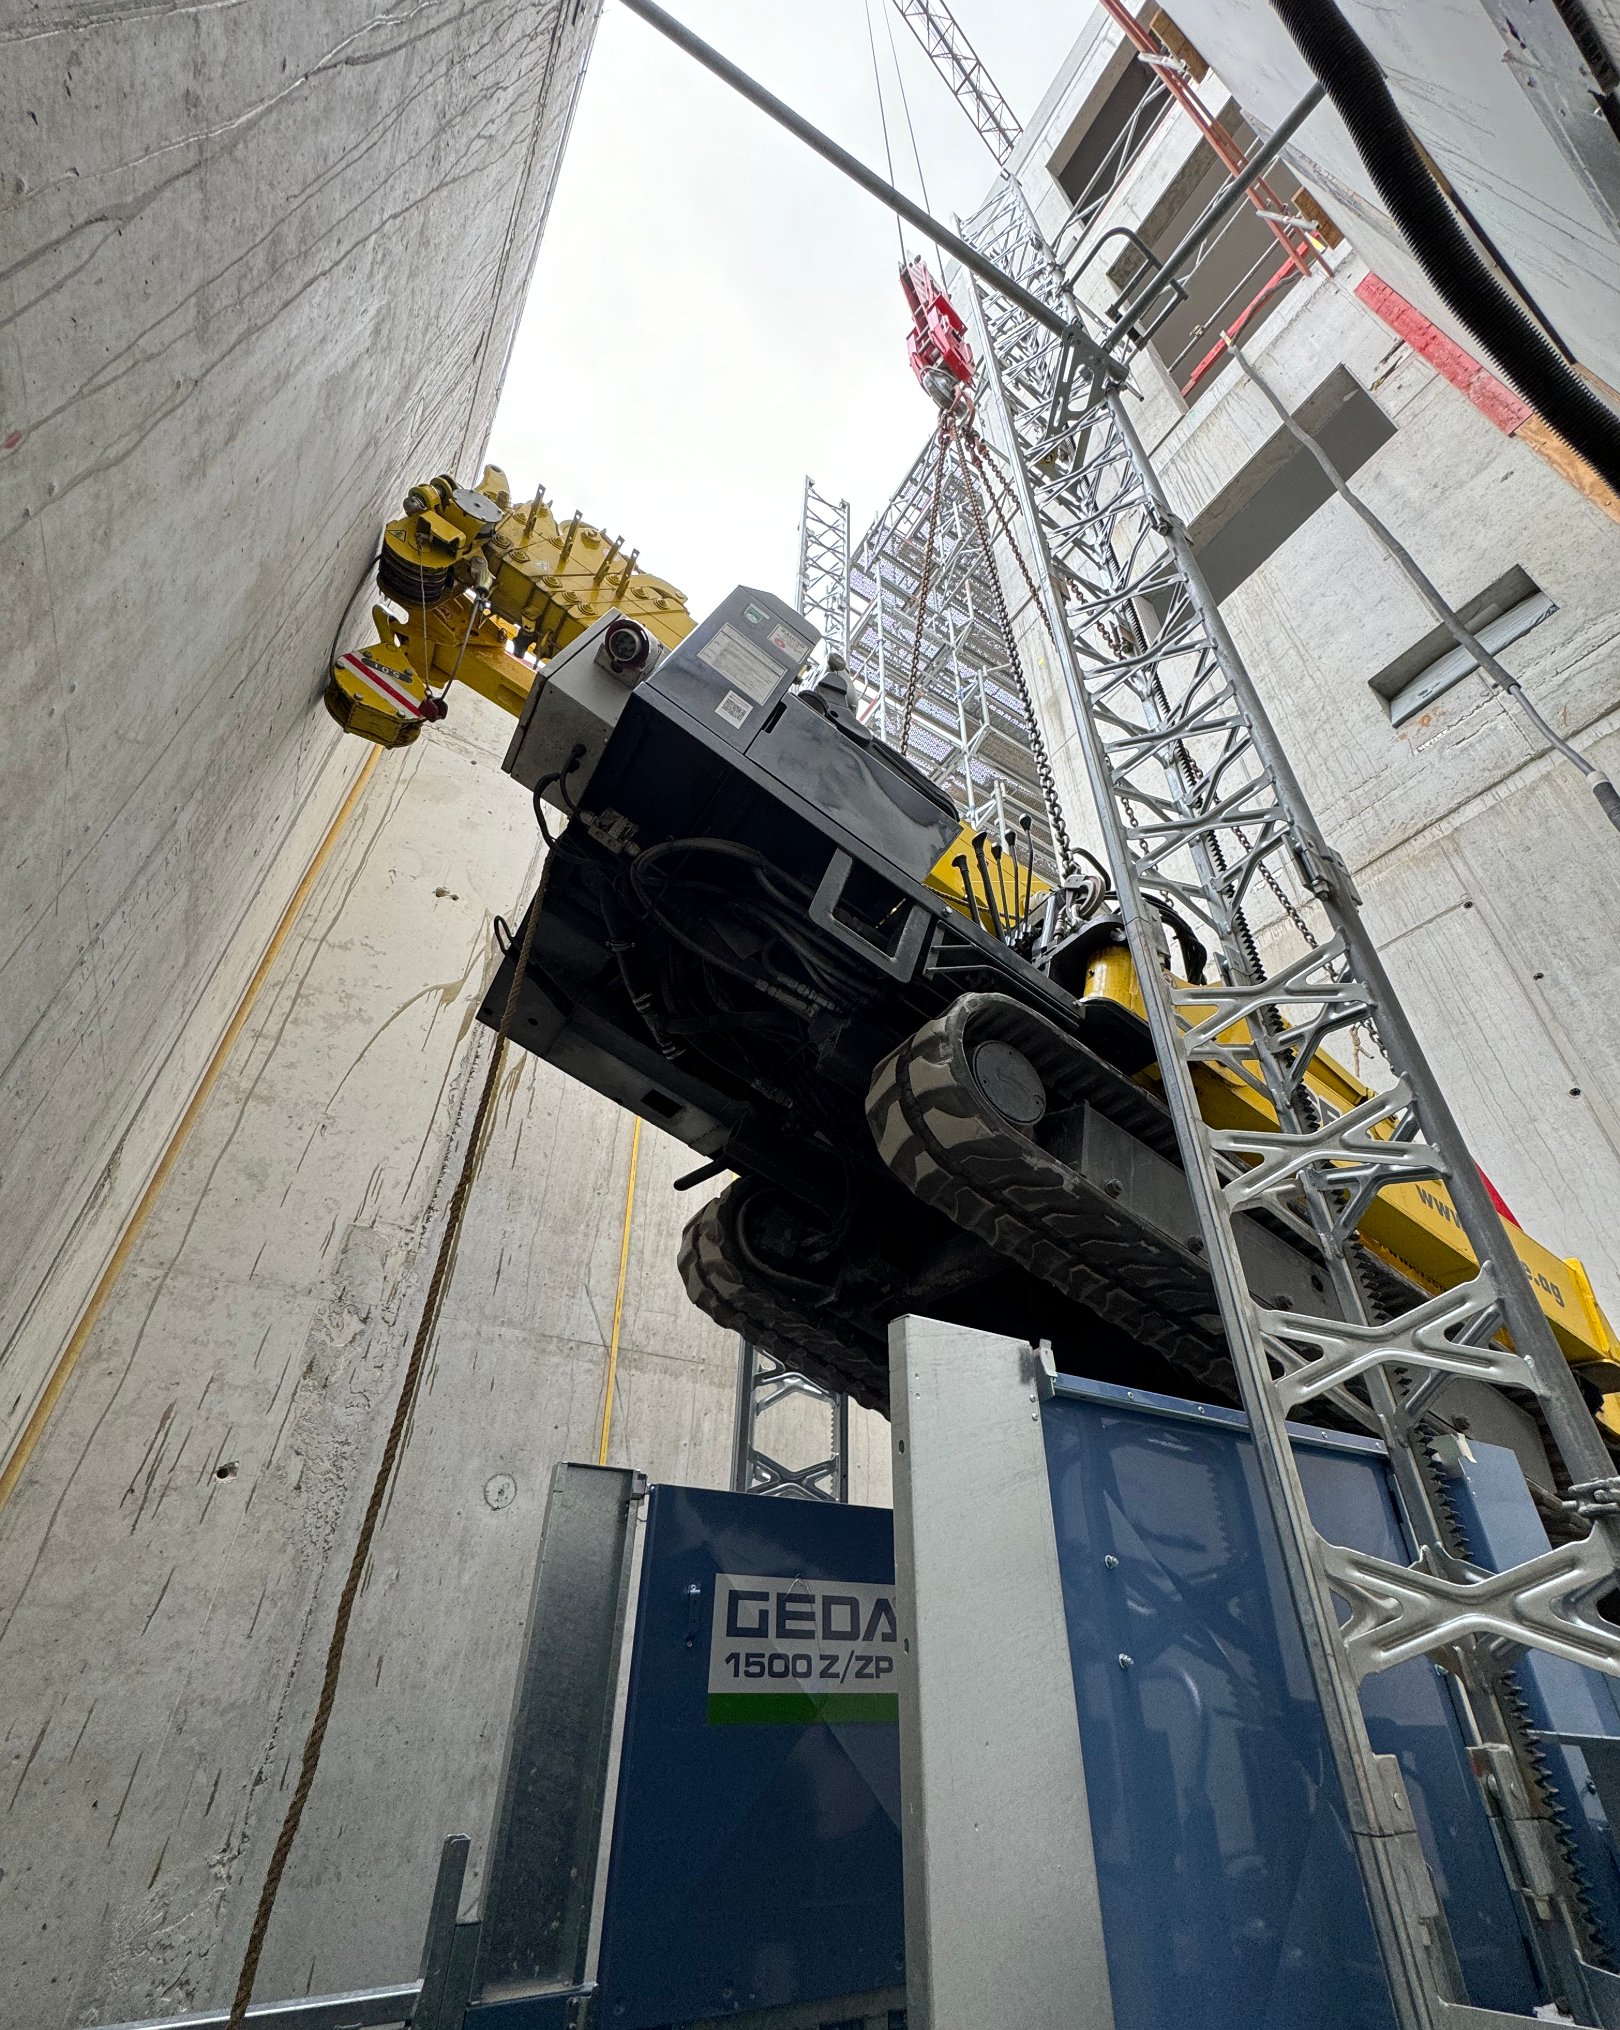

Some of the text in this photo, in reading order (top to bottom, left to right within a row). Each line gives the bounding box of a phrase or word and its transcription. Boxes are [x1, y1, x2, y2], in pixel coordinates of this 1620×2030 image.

[726, 1589, 897, 1643] GEDA
[725, 1650, 894, 1684] 1500 Z/ZP
